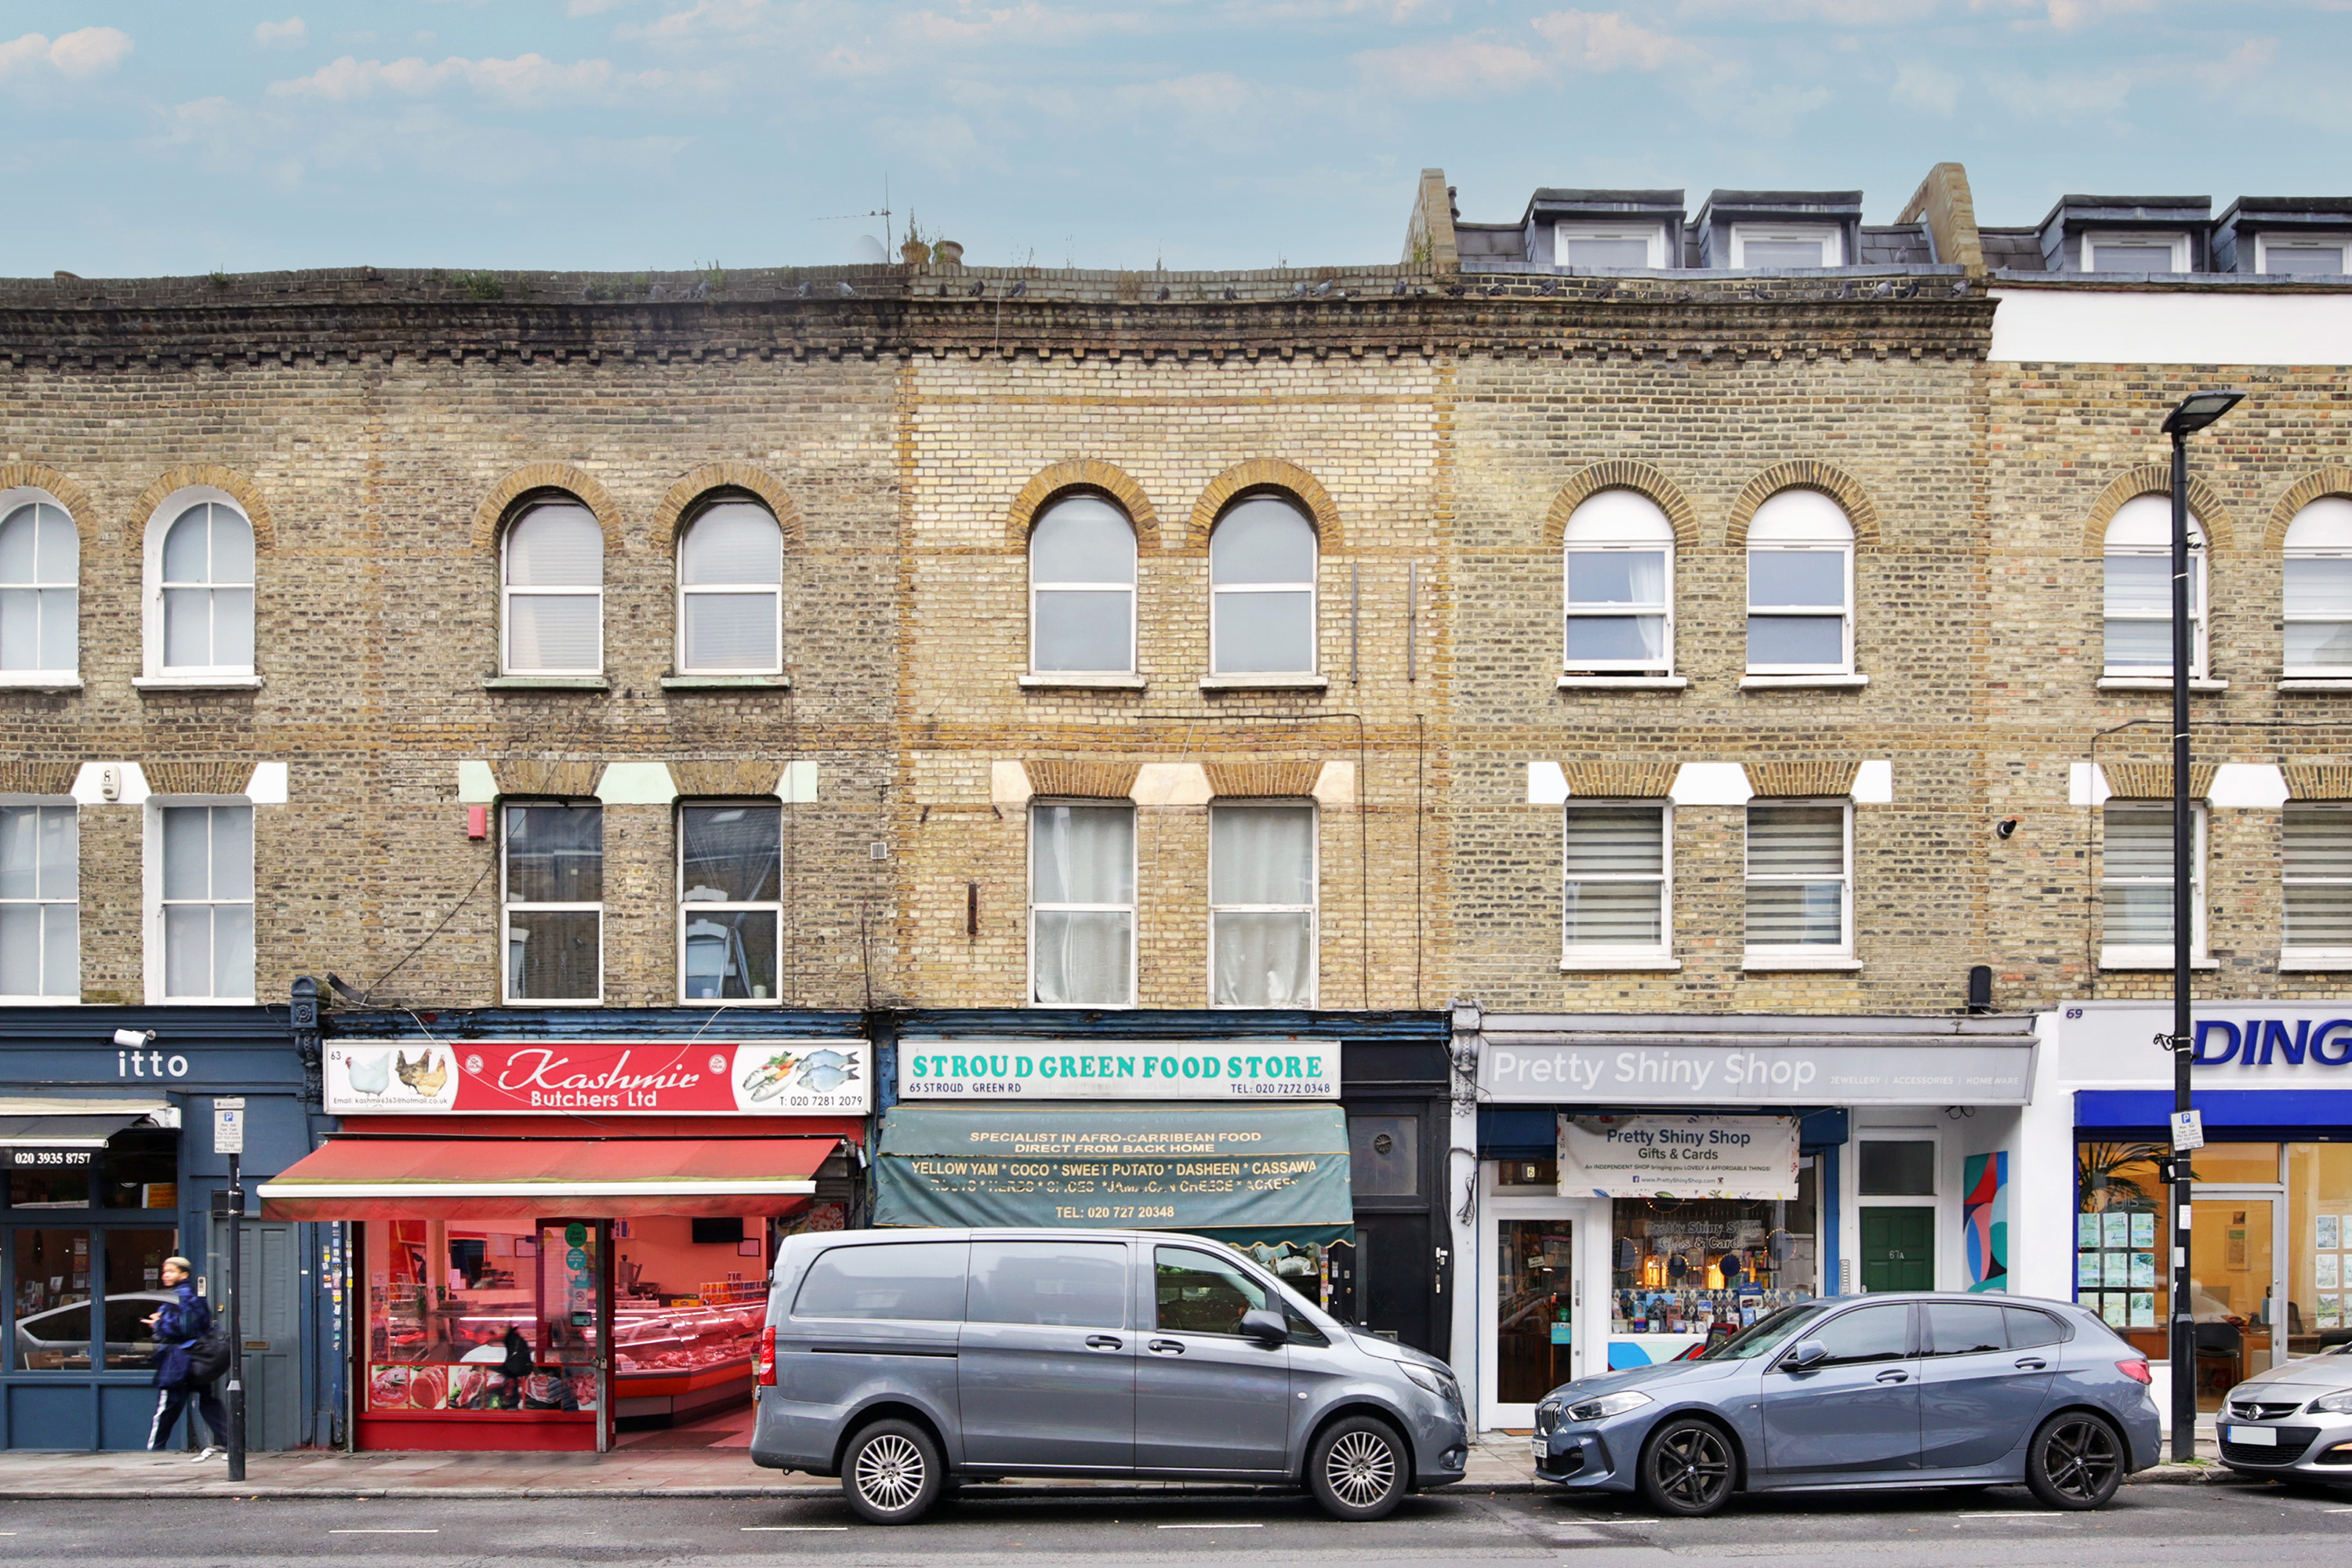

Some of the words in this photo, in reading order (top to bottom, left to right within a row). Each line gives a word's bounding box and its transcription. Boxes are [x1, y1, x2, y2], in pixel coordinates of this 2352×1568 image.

[2066, 1009, 2083, 1019] 69
[331, 1051, 341, 1060] 63
[119, 1051, 189, 1077] itto
[498, 1048, 699, 1091] Kashmir
[1039, 1055, 1135, 1078] GREEN
[1142, 1055, 1221, 1079] FOOD
[1227, 1055, 1323, 1079] STORE
[1494, 1052, 1605, 1091] Pretty
[1614, 1051, 1714, 1091] Shiny
[1723, 1052, 1817, 1091] Shop
[1829, 1076, 1881, 1084] JEWELLERY
[1893, 1076, 1954, 1085] ACCESSORIES
[909, 1083, 921, 1093] 65
[924, 1083, 964, 1093] STROUD
[972, 1083, 1004, 1093] GREEN
[1007, 1083, 1022, 1093] RD
[1231, 1083, 1253, 1094] TEL:
[1256, 1083, 1275, 1094] 020
[1277, 1083, 1301, 1094] 7272
[1305, 1083, 1330, 1094] 0348
[531, 1091, 619, 1107] Butchers
[628, 1091, 657, 1107] Ltd
[780, 1096, 788, 1106] T:
[790, 1096, 808, 1106] 020
[812, 1096, 835, 1106] 7281
[839, 1096, 862, 1106] 2079
[970, 1132, 1058, 1142] SPECIALIST
[1061, 1134, 1076, 1142] IN
[1080, 1133, 1214, 1143] AFRO-CARRIBEAN
[1219, 1132, 1261, 1142] FOOD
[1607, 1129, 1655, 1146] Pretty
[1659, 1129, 1704, 1147] Shiny
[1709, 1129, 1751, 1147] Shop
[1014, 1145, 1070, 1153] DIRECT
[1074, 1145, 1119, 1153] FROM
[1123, 1144, 1167, 1153] BACK
[1170, 1144, 1214, 1152] HOME
[1638, 1147, 1667, 1160] Gifts
[1669, 1149, 1679, 1160] &
[1682, 1149, 1719, 1160] Cards
[15, 1152, 34, 1164] 020
[37, 1152, 64, 1164] 3935
[65, 1152, 91, 1164] 8757
[911, 1161, 968, 1175] YELLOW
[970, 1163, 998, 1176] YAM
[1010, 1163, 1050, 1177] COCO
[1061, 1164, 1109, 1177] SWEET
[1112, 1163, 1164, 1177] POTATO
[1176, 1162, 1240, 1176] DASHEEN
[1055, 1207, 1084, 1218] TEL:
[1087, 1207, 1110, 1218] 020
[1113, 1207, 1134, 1218] 727
[1138, 1206, 1174, 1218] 20348
[1688, 1220, 1724, 1235] Shiny
[1694, 1236, 1705, 1249] &
